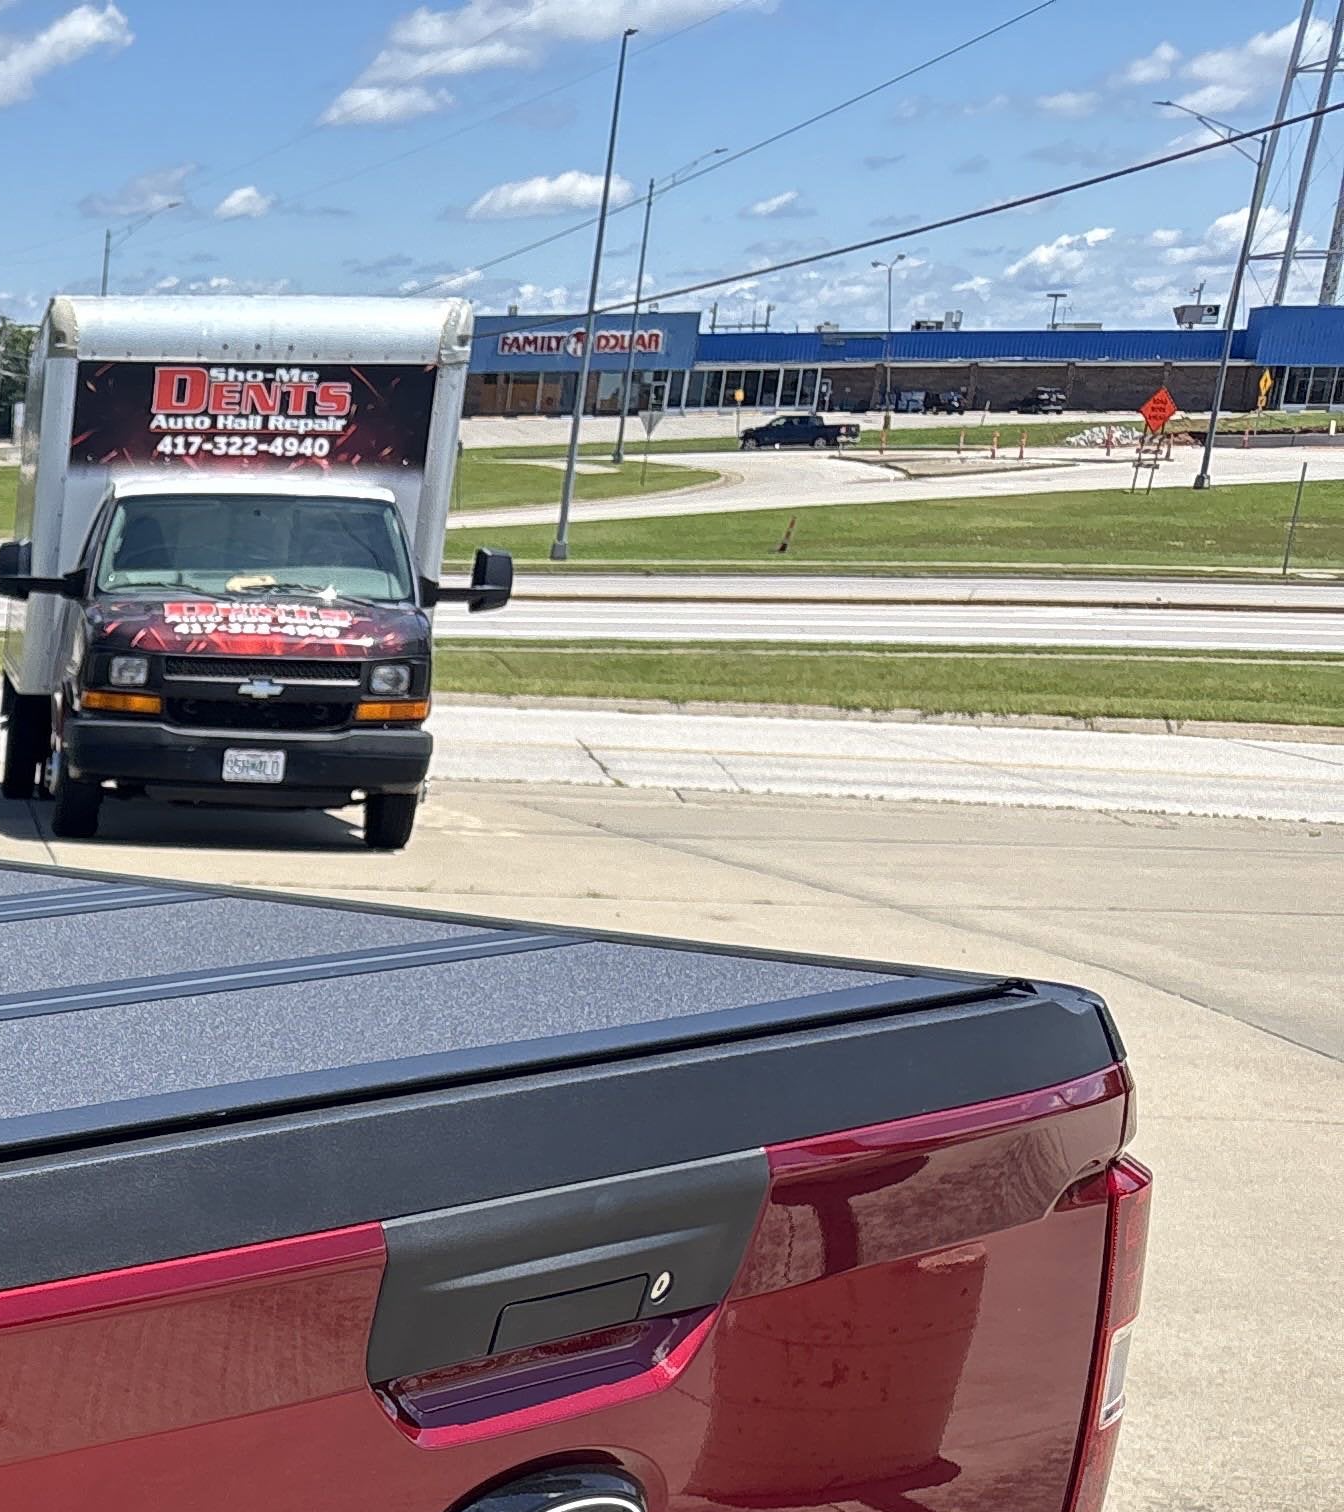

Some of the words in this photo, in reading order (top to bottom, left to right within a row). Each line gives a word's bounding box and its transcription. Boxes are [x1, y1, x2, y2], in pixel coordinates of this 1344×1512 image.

[500, 334, 566, 353] FAMILY
[596, 333, 661, 353] DOLAR
[209, 367, 320, 382] Sho-Me
[151, 367, 352, 416] DENTS
[149, 415, 212, 430] Auto
[216, 415, 263, 430] Hail
[267, 416, 347, 434] Repair
[156, 434, 330, 457] 417-322-4940
